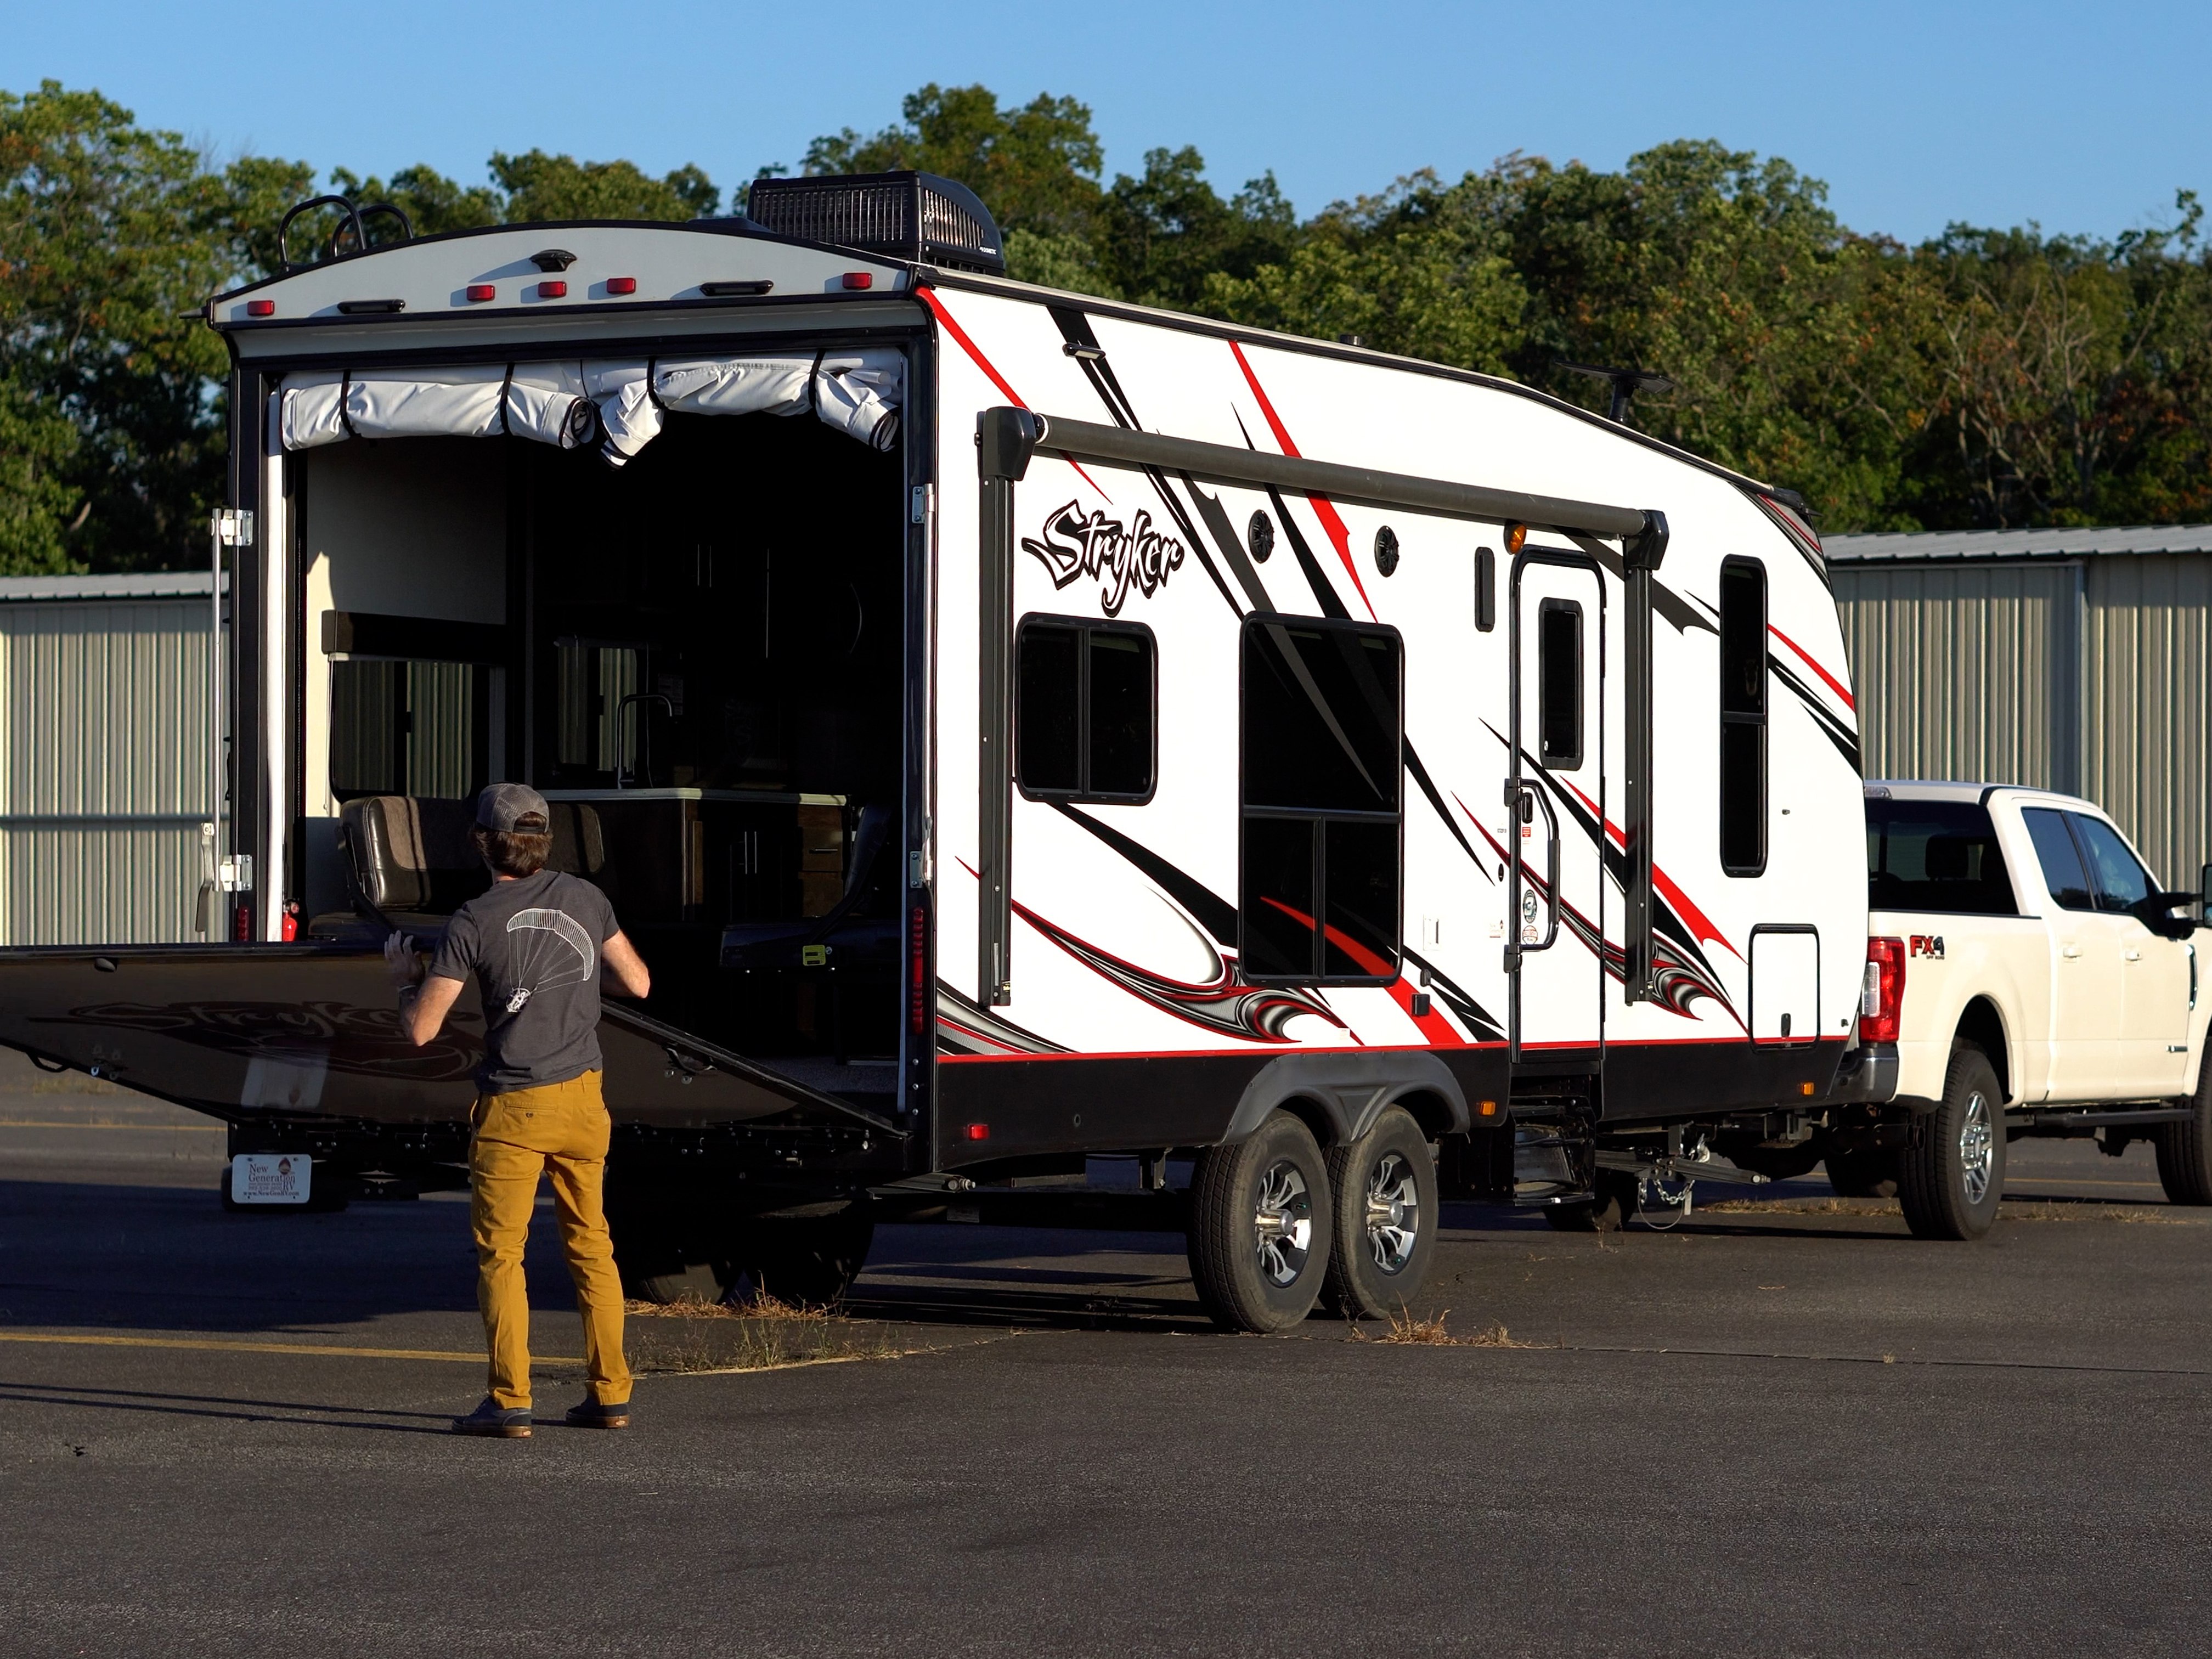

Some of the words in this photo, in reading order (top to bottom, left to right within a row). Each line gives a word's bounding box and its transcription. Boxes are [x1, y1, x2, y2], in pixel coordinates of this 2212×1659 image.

[1021, 498, 1185, 618] Stryker
[1909, 934, 1945, 958] FX4
[26, 1001, 483, 1042] Stryke
[249, 1164, 268, 1173] New
[249, 1173, 296, 1183] Generation
[283, 1182, 295, 1190] RV
